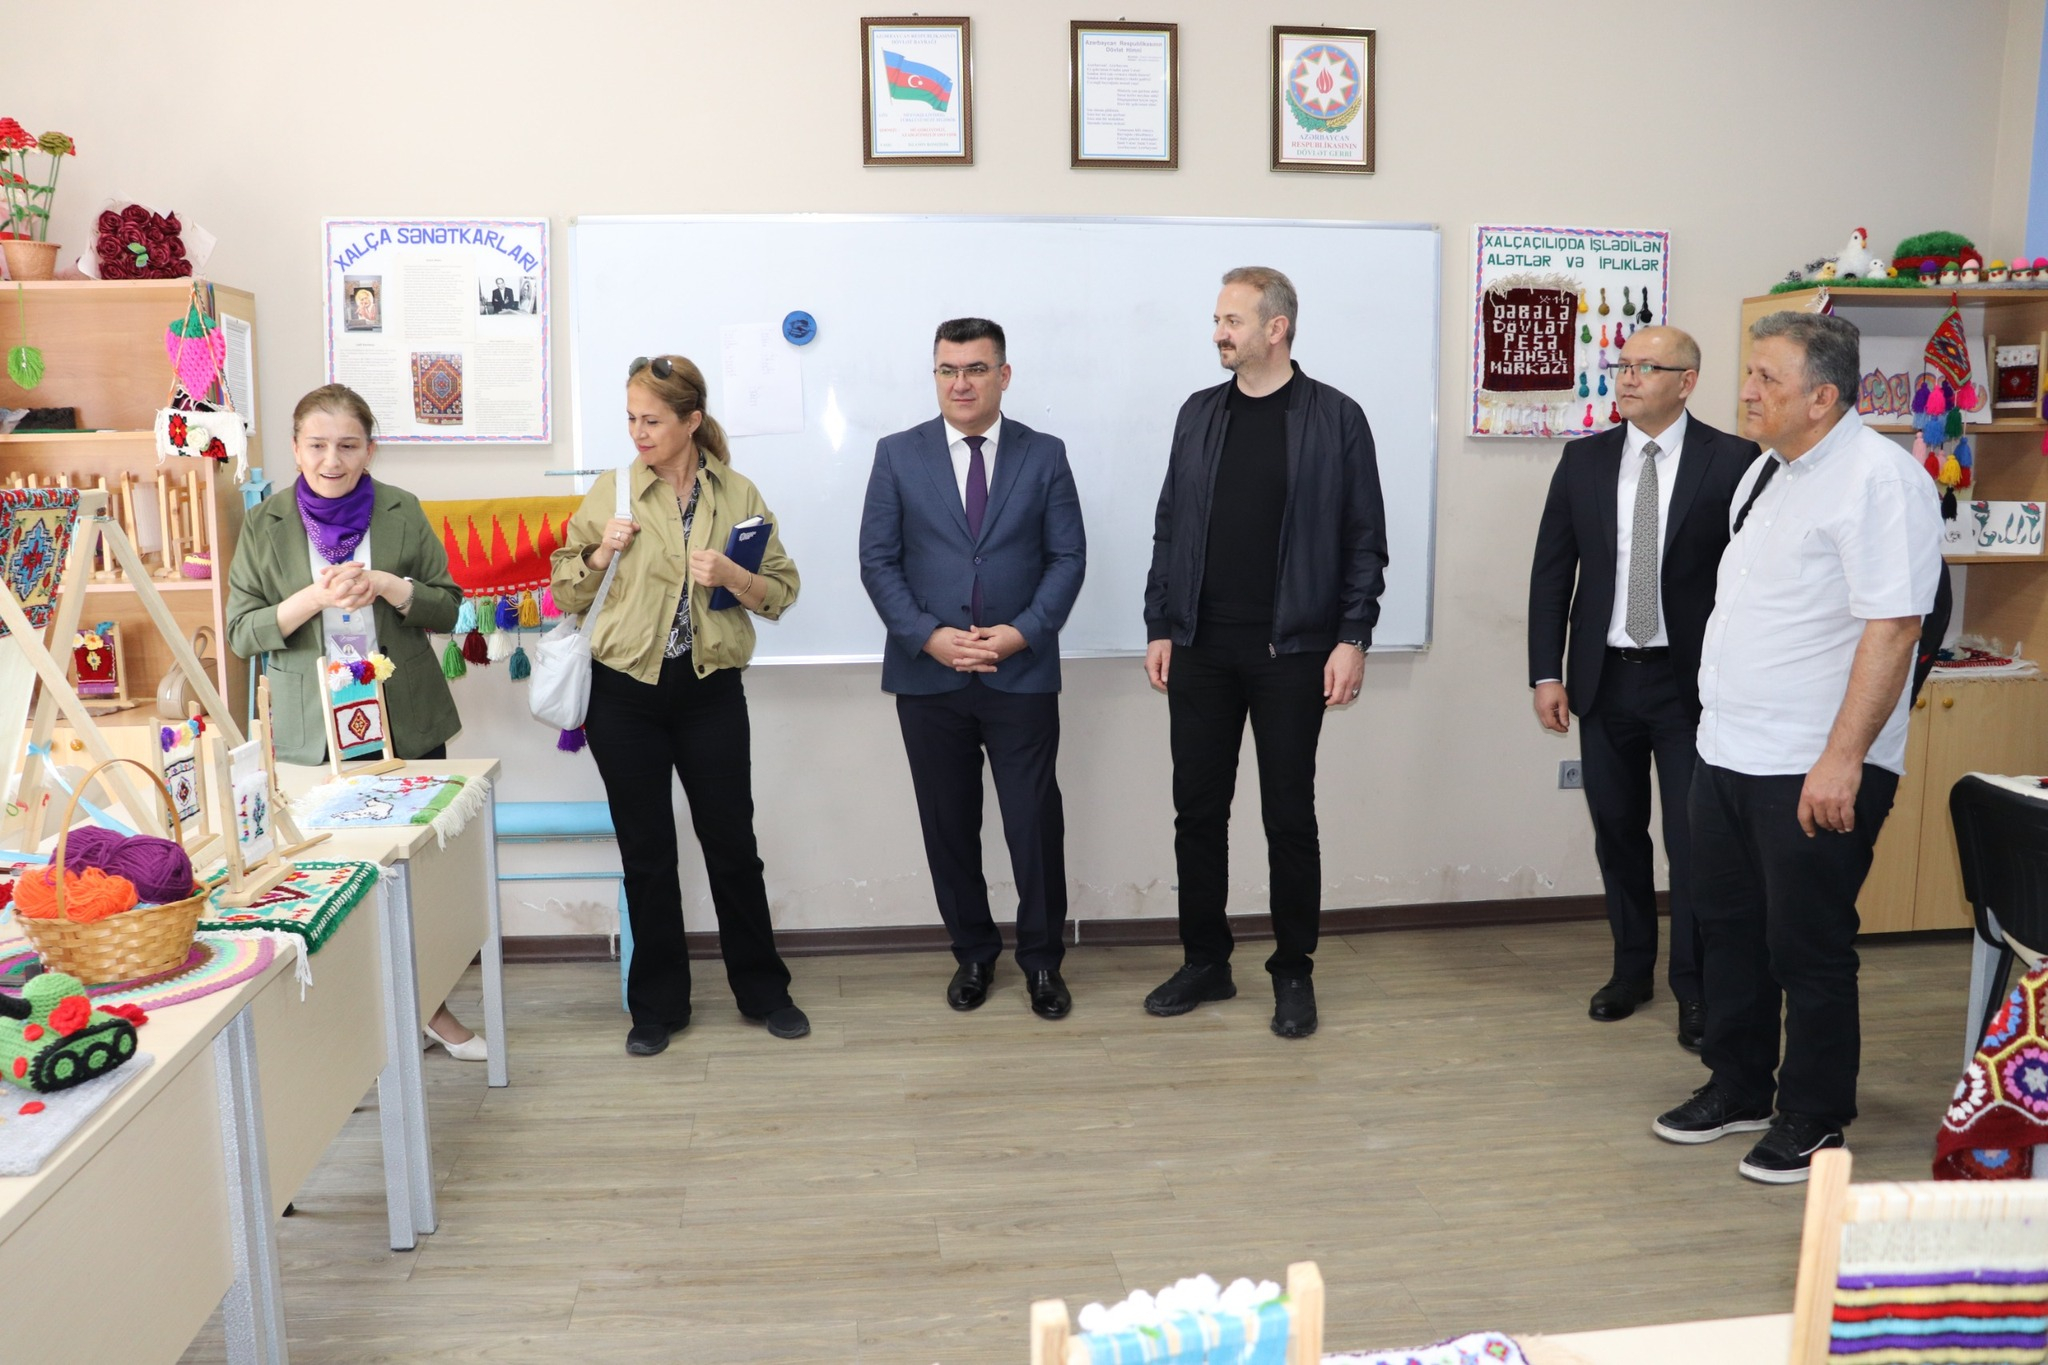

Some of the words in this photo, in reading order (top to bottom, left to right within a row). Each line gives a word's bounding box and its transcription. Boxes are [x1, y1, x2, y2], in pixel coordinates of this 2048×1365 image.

[1297, 149, 1327, 157] DÖVLƏT
[333, 228, 392, 273] XALÇA
[397, 227, 539, 273] SƏNƏTKARLARI
[1484, 235, 1586, 252] XALÇAÇILIQDA
[1590, 237, 1662, 253] İŞLƏDİLƏN
[1487, 253, 1552, 267] ALƏTLƏR
[1566, 256, 1584, 268] VƏ
[1492, 319, 1568, 335] DÖVLƏT
[1504, 333, 1558, 351] PEŞƏ
[1502, 349, 1568, 362] TƏHSİL
[1490, 360, 1569, 375] MƏRKƏZİ
